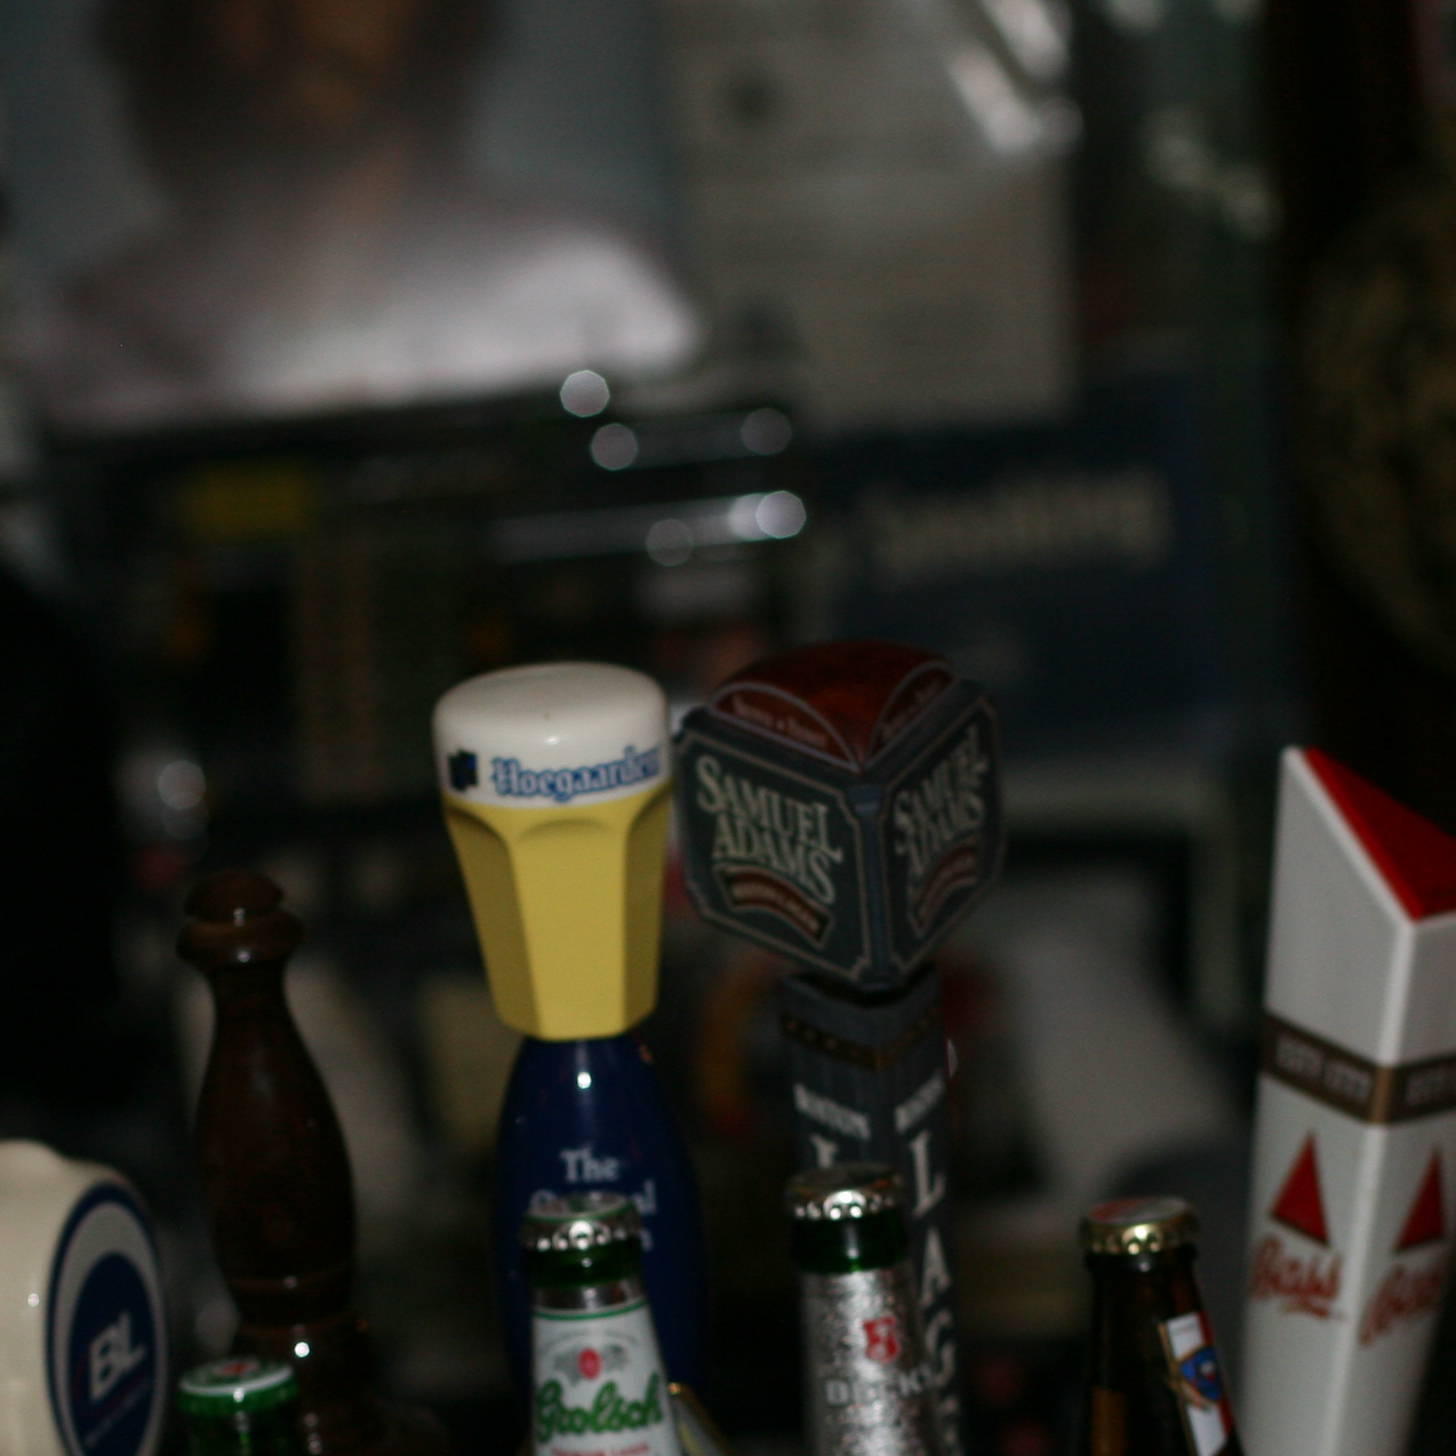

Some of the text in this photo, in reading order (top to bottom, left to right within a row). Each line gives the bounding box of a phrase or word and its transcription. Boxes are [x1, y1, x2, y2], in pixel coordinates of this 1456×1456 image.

[491, 746, 661, 801] Hoegaarden
[696, 755, 844, 864] SAMUEL
[894, 722, 990, 856] SAMUEL
[710, 812, 836, 906] ADAMS
[558, 1143, 622, 1184] The
[88, 1309, 147, 1403] BL
[533, 1372, 662, 1443] Grolsch
